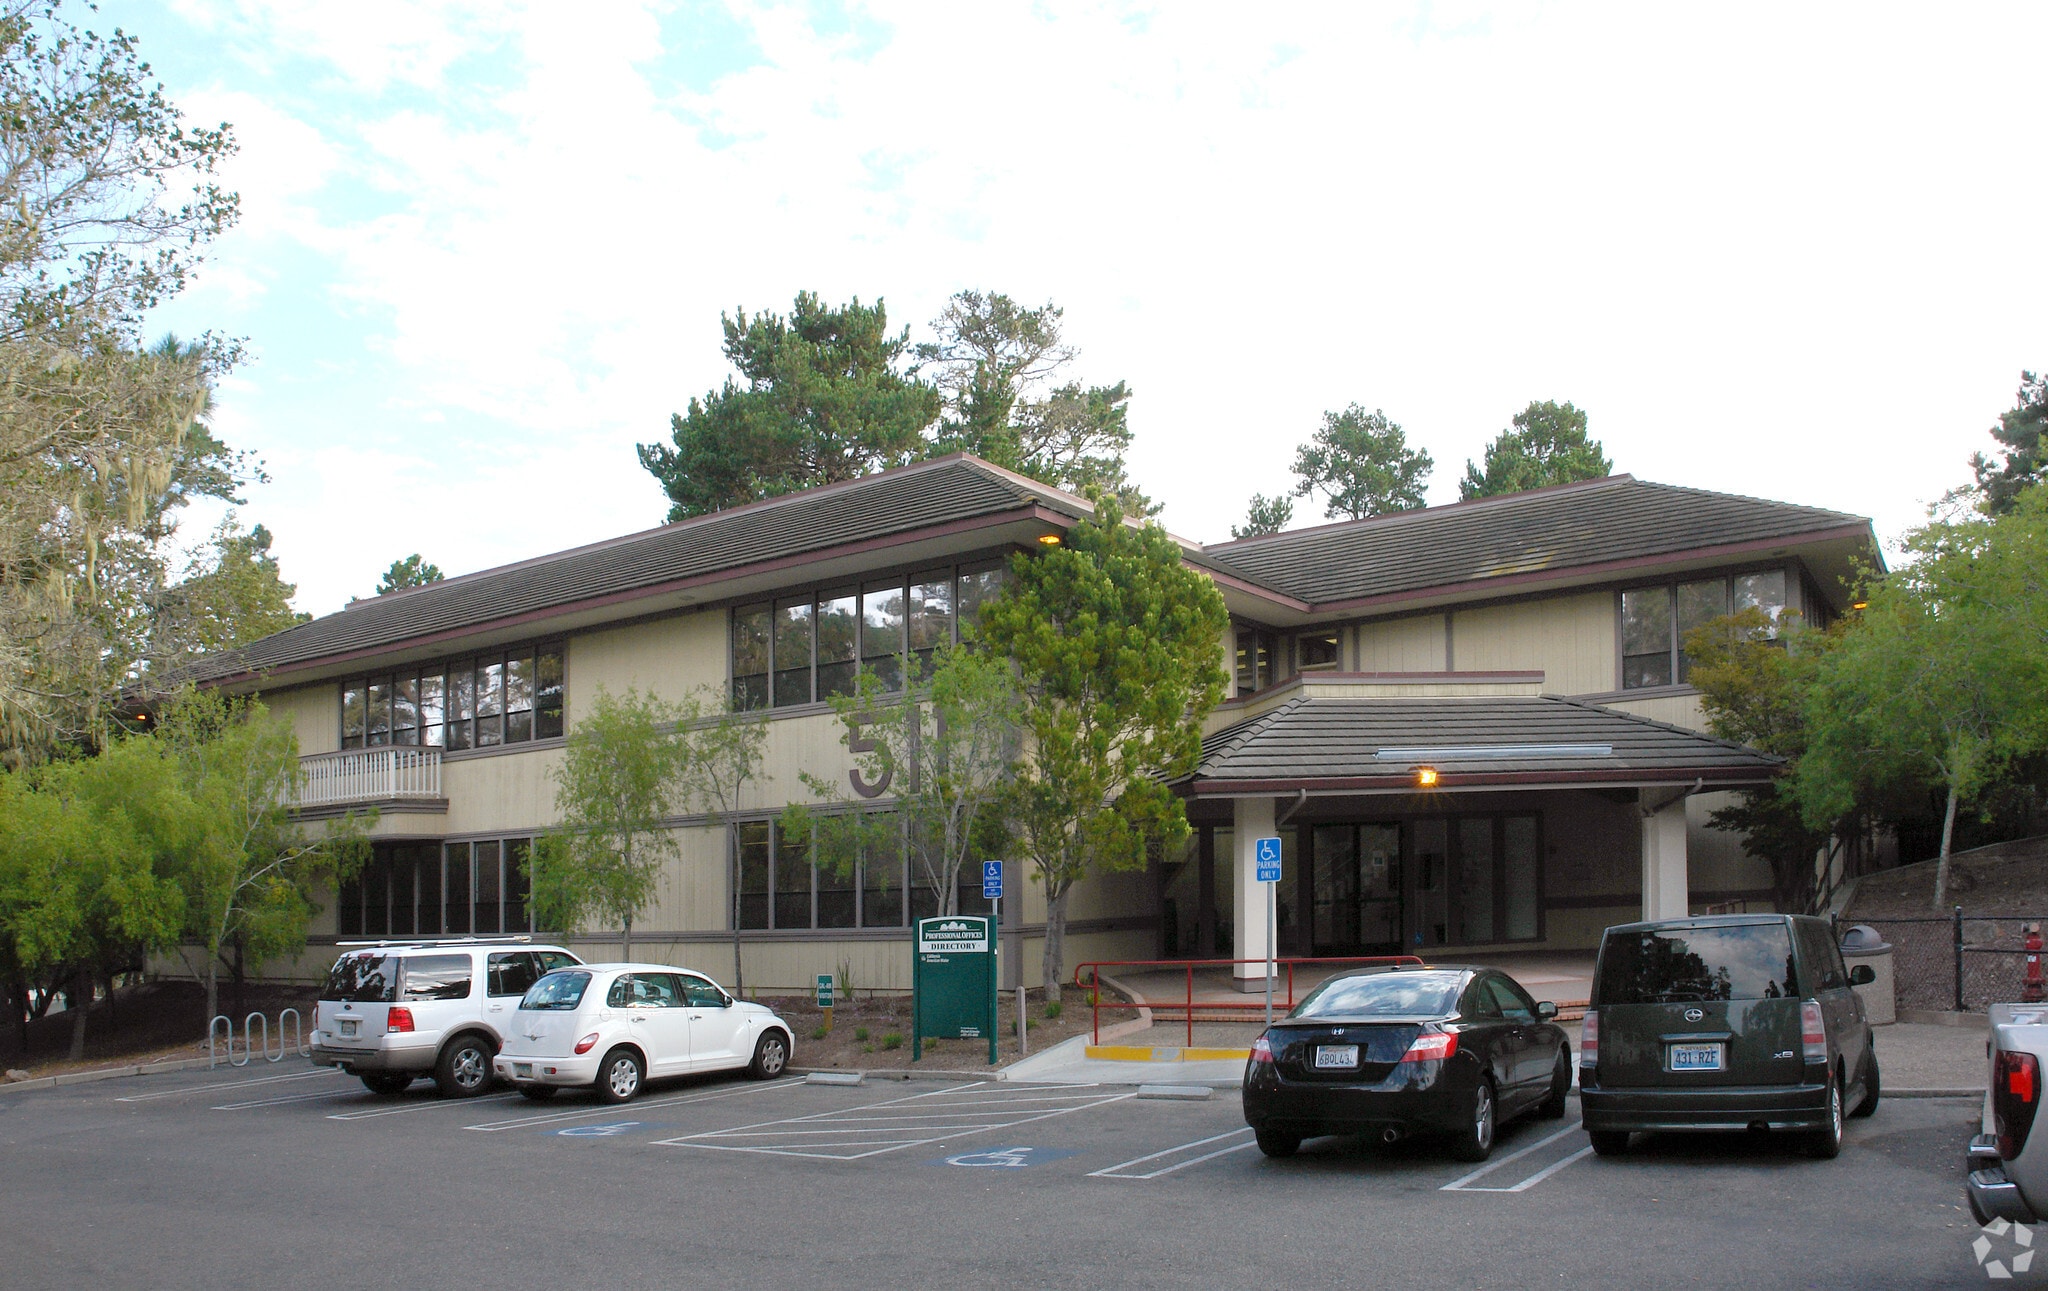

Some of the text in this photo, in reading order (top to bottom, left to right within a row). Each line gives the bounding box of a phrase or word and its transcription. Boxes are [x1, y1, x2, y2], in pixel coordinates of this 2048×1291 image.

[1257, 860, 1280, 869] PARKING
[1261, 870, 1276, 879] ONLY
[962, 931, 982, 939] OFFICES
